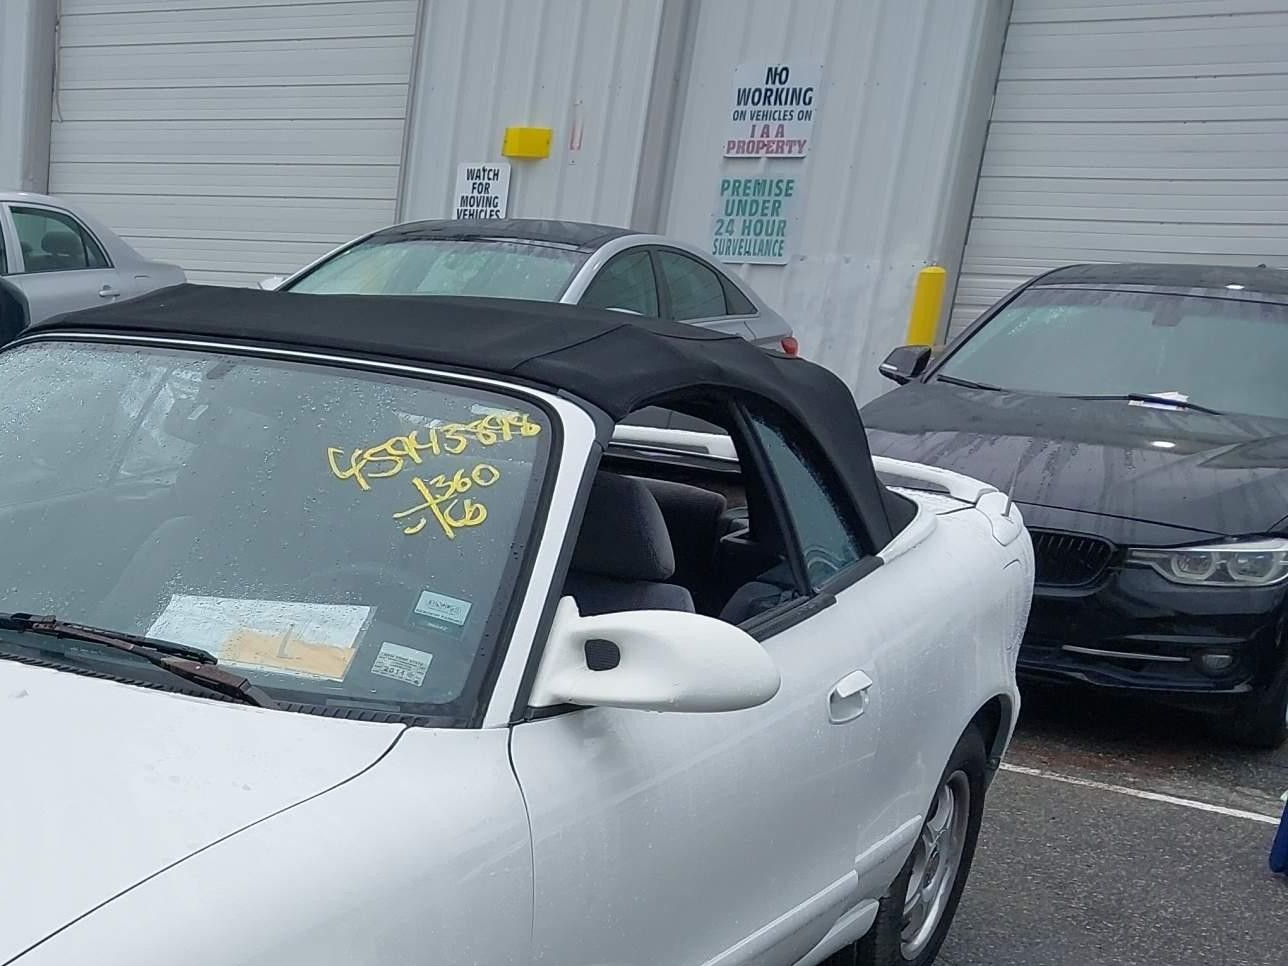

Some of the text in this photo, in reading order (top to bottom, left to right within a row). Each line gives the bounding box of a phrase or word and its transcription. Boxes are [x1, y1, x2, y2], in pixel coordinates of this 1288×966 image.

[765, 66, 790, 86] NO
[736, 87, 814, 107] WORKING
[732, 109, 813, 121] ON VEHICLES ON
[726, 139, 808, 155] PROPERTY
[466, 167, 500, 181] WATCH
[471, 182, 491, 194] FOR
[720, 178, 795, 197] PREMISE
[460, 195, 500, 208] MOVING
[724, 199, 782, 217] UNDER
[714, 218, 787, 237] 24 HOUR
[712, 237, 785, 257] SURVEILLANCE
